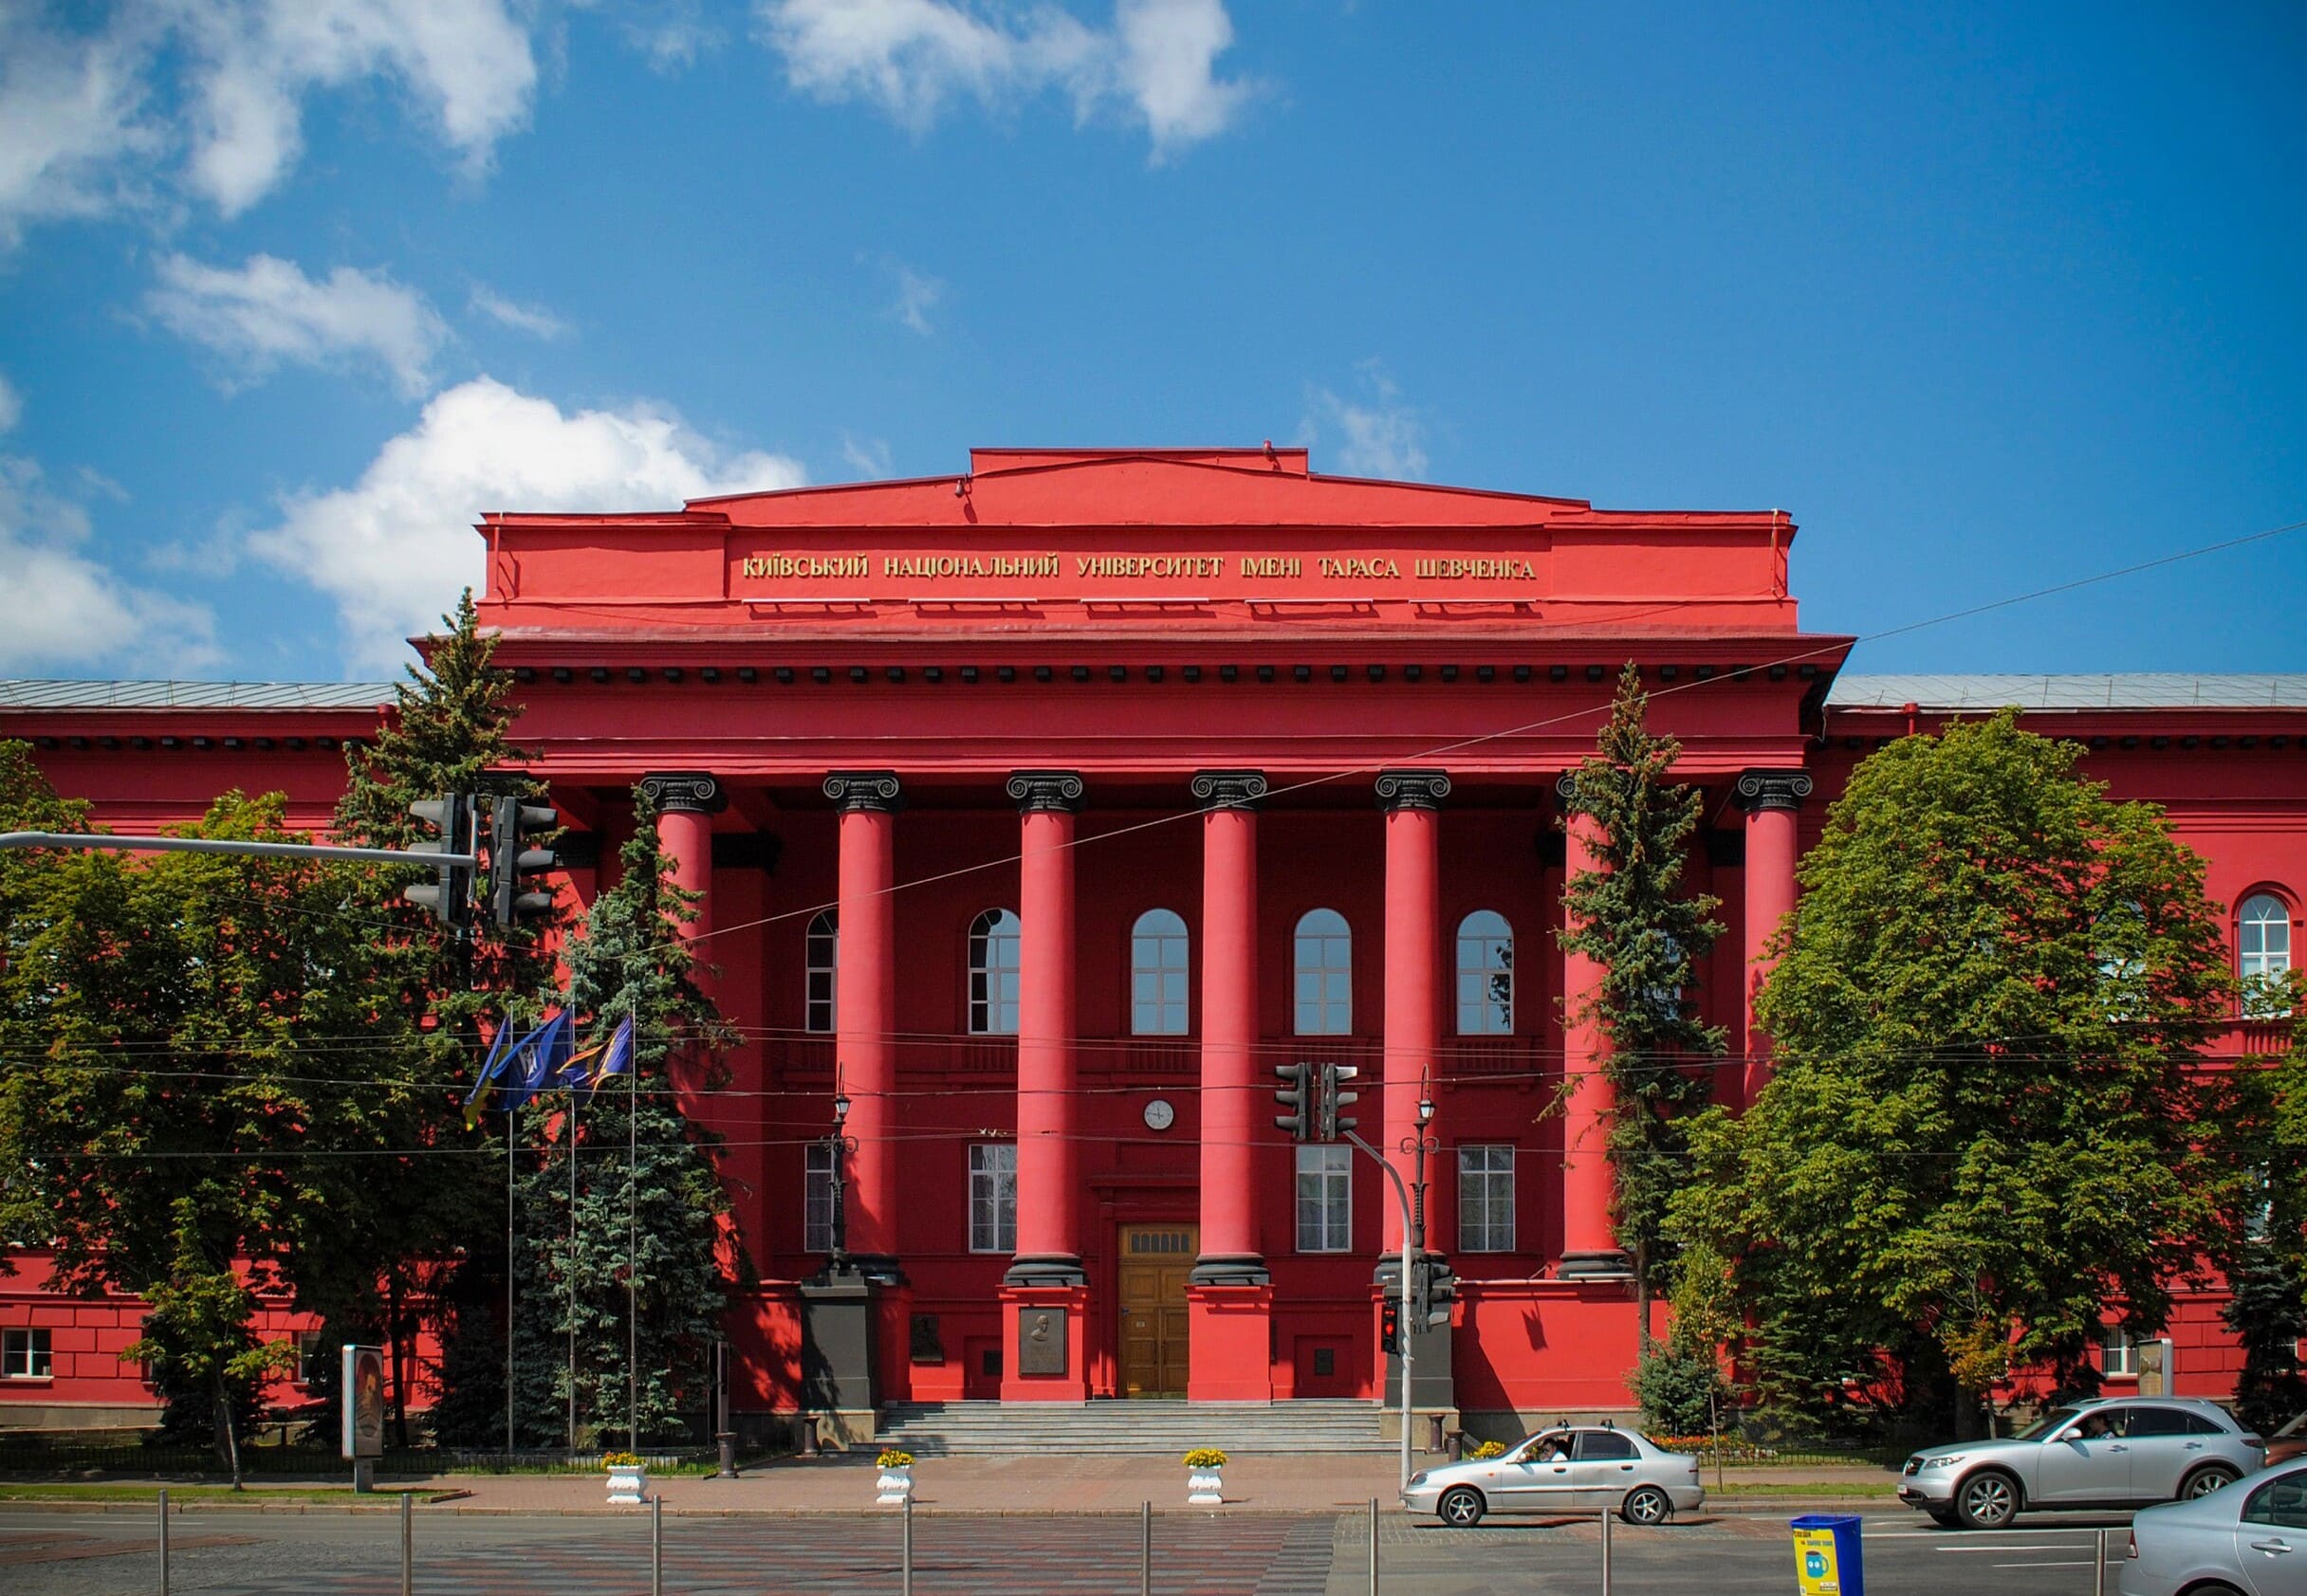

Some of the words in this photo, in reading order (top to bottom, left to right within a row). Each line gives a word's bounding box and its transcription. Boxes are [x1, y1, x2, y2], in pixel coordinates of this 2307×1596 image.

[743, 554, 869, 578] КИЇВСЬКИЙ
[884, 554, 1059, 579] НАЦІОНАЛЬНИЙ
[1076, 558, 1224, 578] УНІВЕРСИТЕТ
[1241, 558, 1301, 578] ІМЕНІ
[1318, 558, 1401, 578] ТАРАСА
[1414, 559, 1536, 579] ШЕВЧЕНКА
